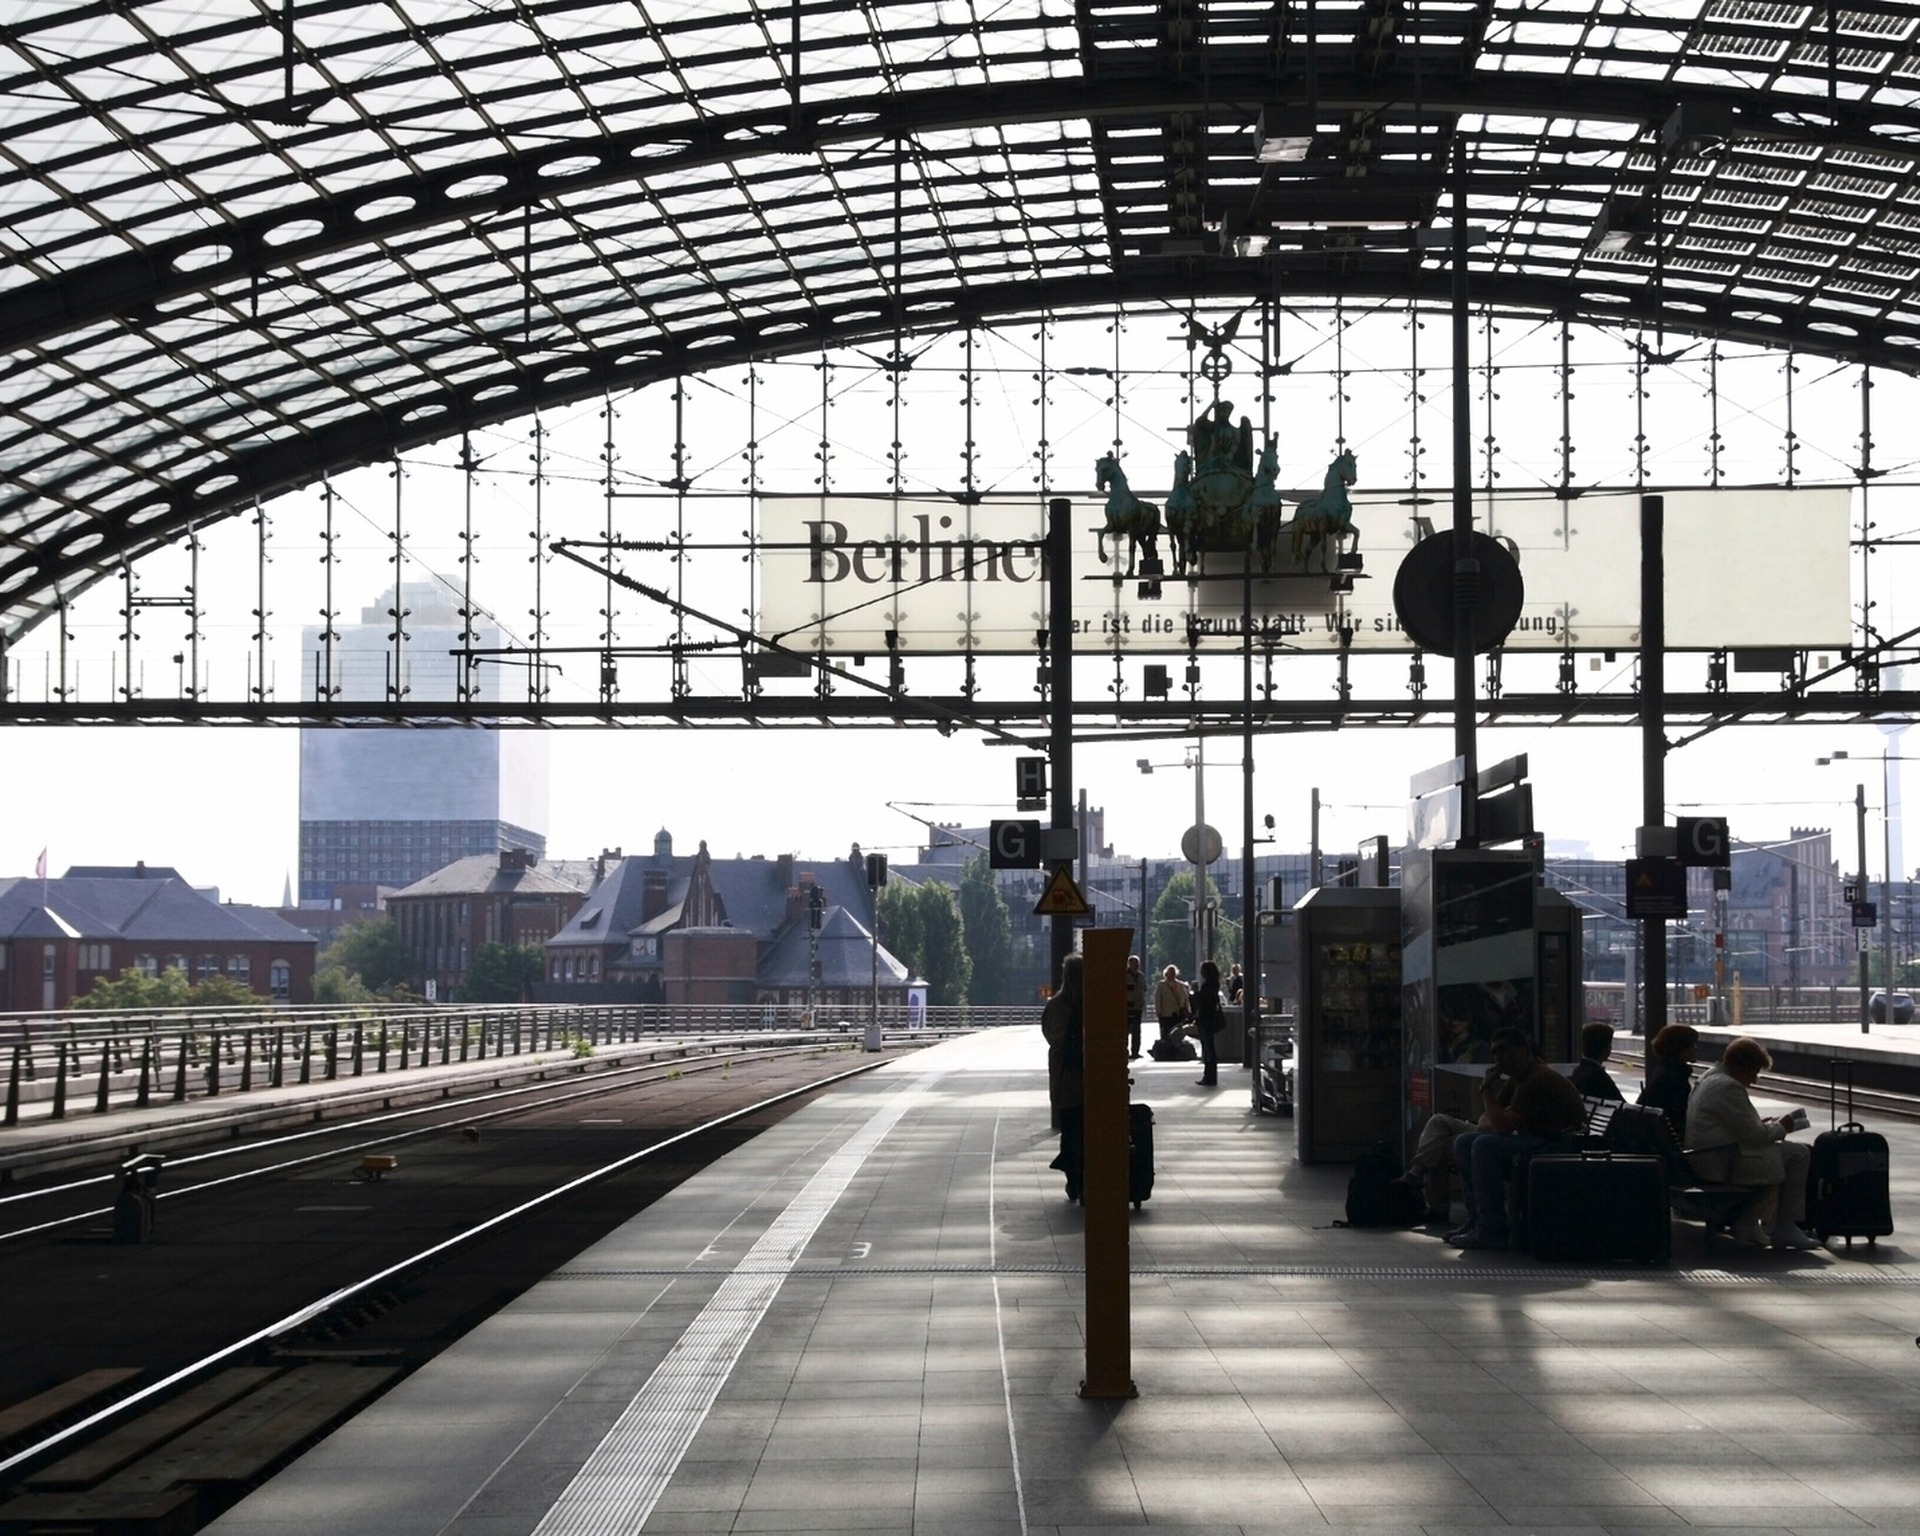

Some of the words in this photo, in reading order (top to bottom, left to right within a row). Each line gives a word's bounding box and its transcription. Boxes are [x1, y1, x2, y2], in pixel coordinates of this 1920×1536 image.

[1103, 614, 1130, 633] ist
[1142, 614, 1174, 633] die
[1325, 613, 1362, 632] Wir
[1374, 613, 1405, 632] sin
[1512, 616, 1565, 636] ung.
[1020, 761, 1042, 791] H
[997, 822, 1025, 859] G
[1692, 818, 1721, 856] G
[1846, 888, 1856, 900] H
